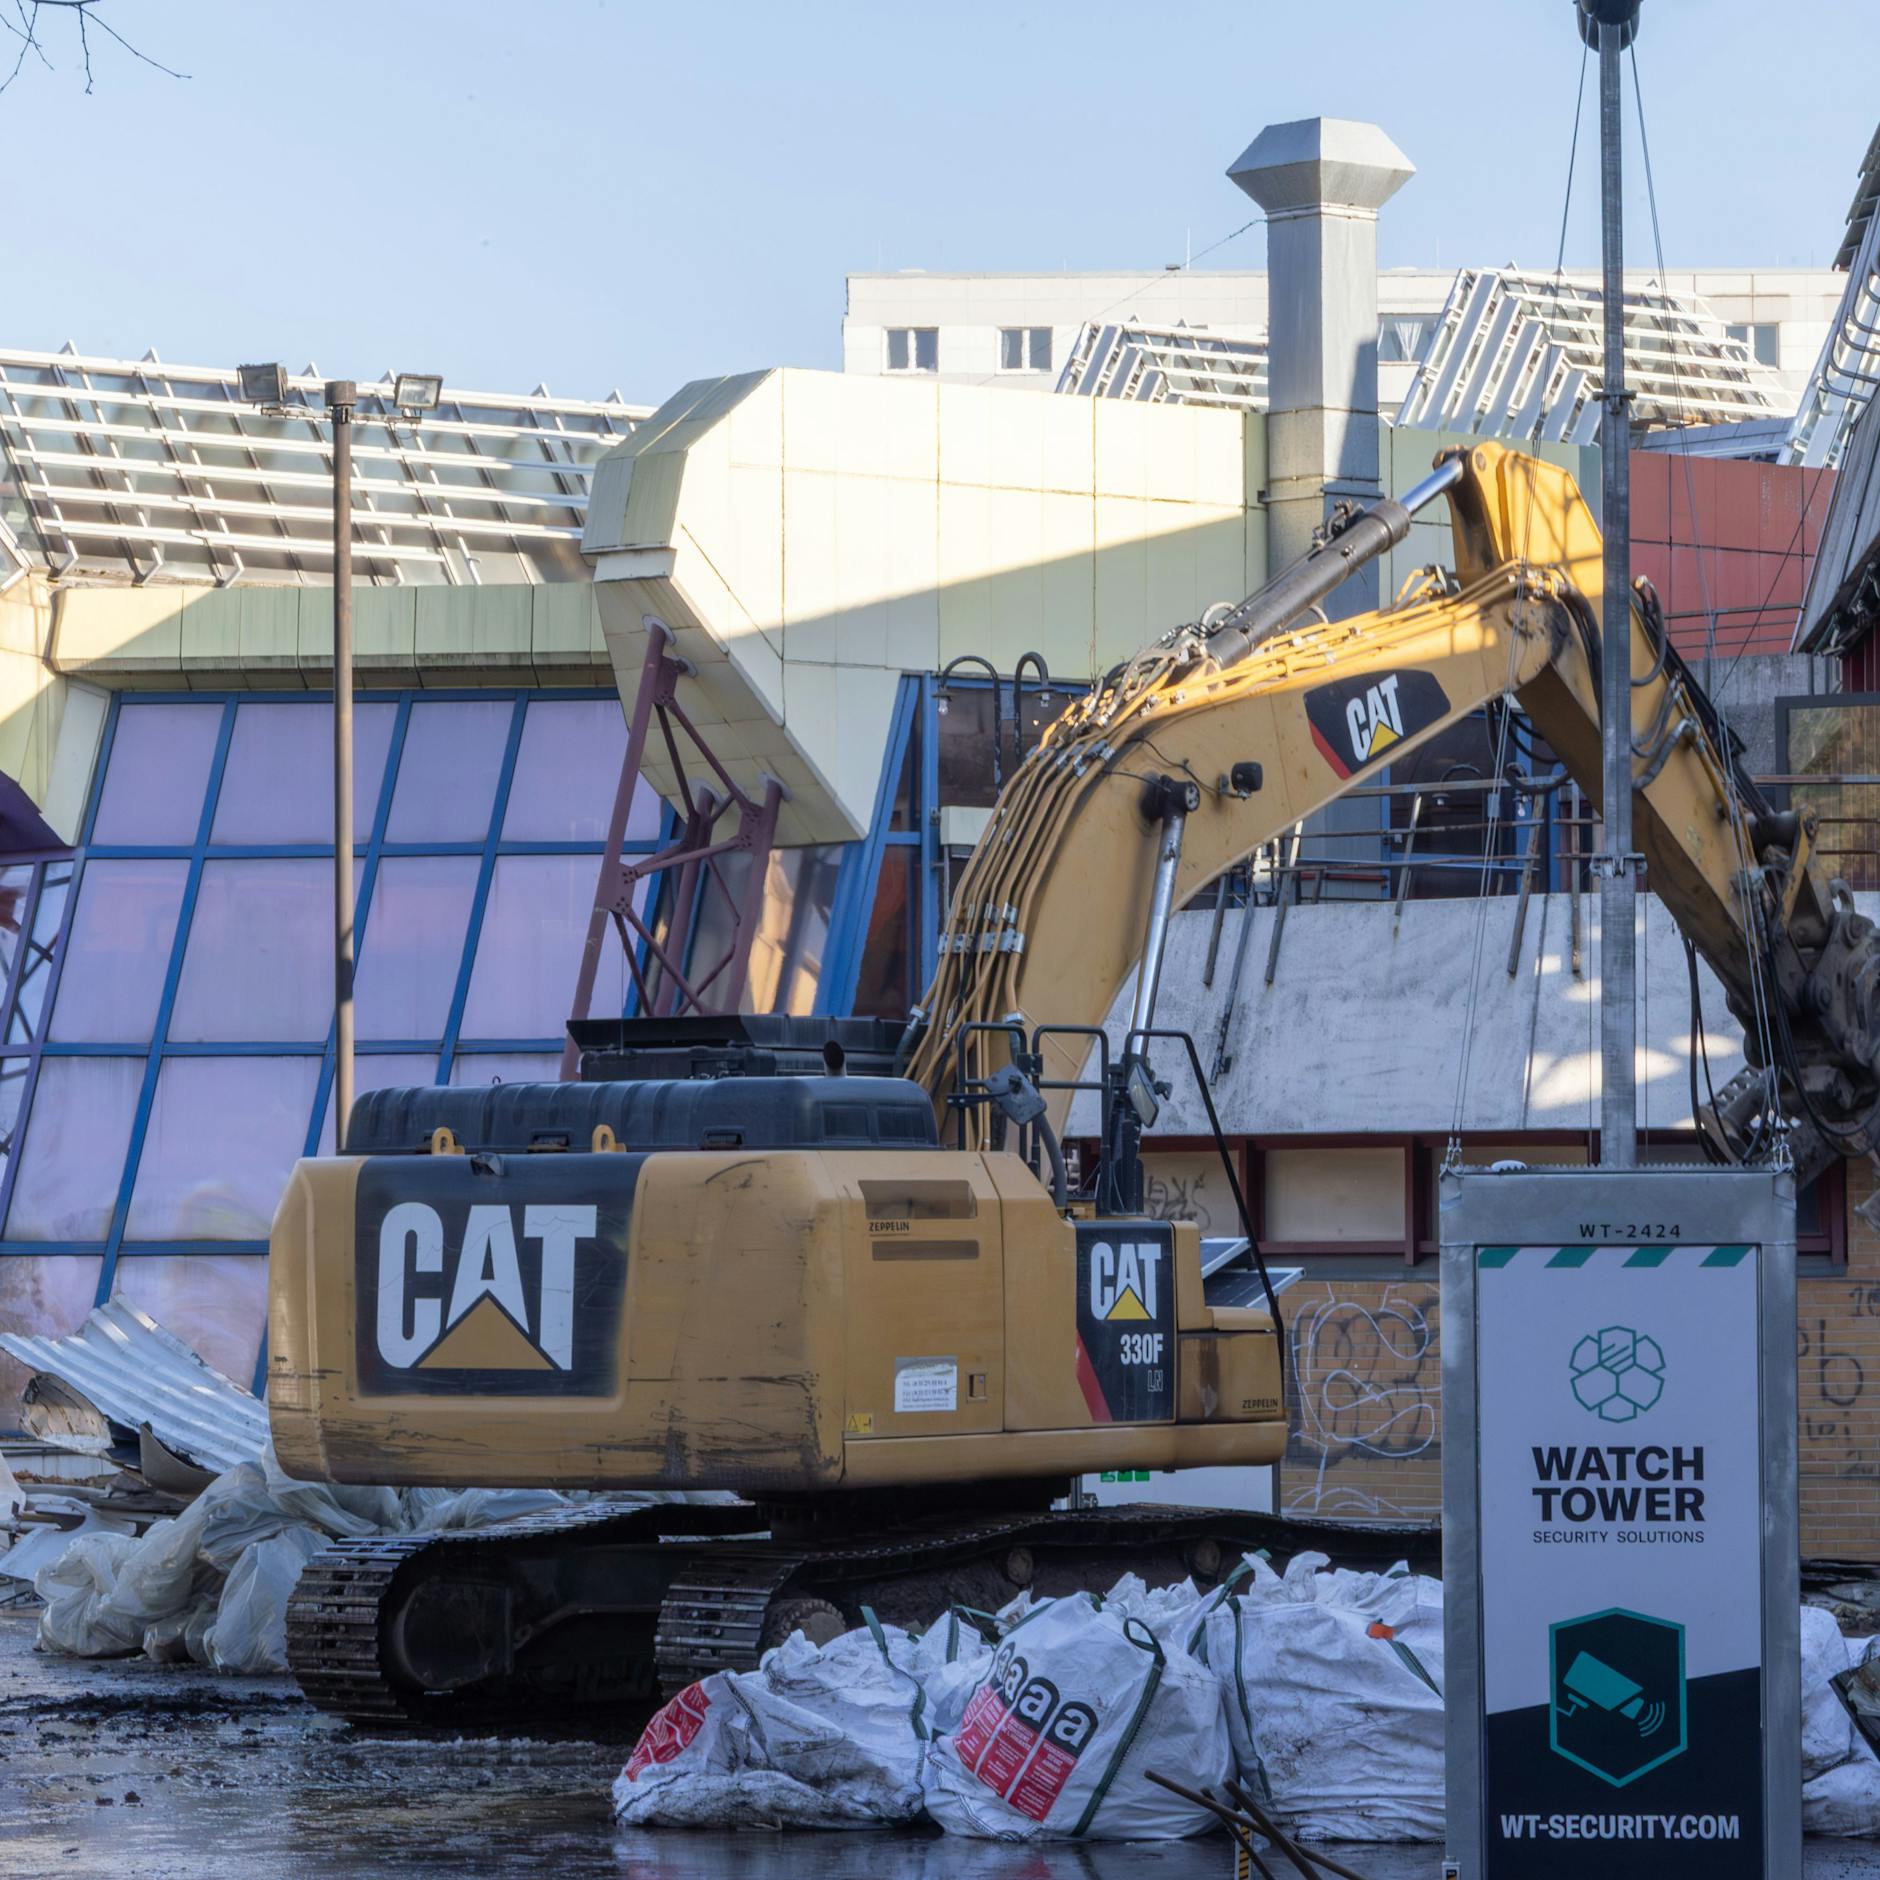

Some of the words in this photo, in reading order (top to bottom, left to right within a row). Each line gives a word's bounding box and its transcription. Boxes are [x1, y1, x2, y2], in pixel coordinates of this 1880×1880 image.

[1346, 673, 1404, 761] CAT
[868, 1221, 910, 1231] ZEPPELIN
[1579, 1223, 1681, 1238] WT-2424
[376, 1202, 597, 1371] CAT
[1090, 1241, 1162, 1321] CAT
[1120, 1333, 1163, 1365] 330F
[1242, 1399, 1278, 1409] ZEPPELIN
[1531, 1446, 1704, 1481] WATCH
[1532, 1487, 1705, 1522] TOWER
[1533, 1530, 1608, 1544] SECURITY
[1617, 1530, 1704, 1544] SOLUTIONS
[1500, 1814, 1740, 1839] WT-SECURITY.COM
